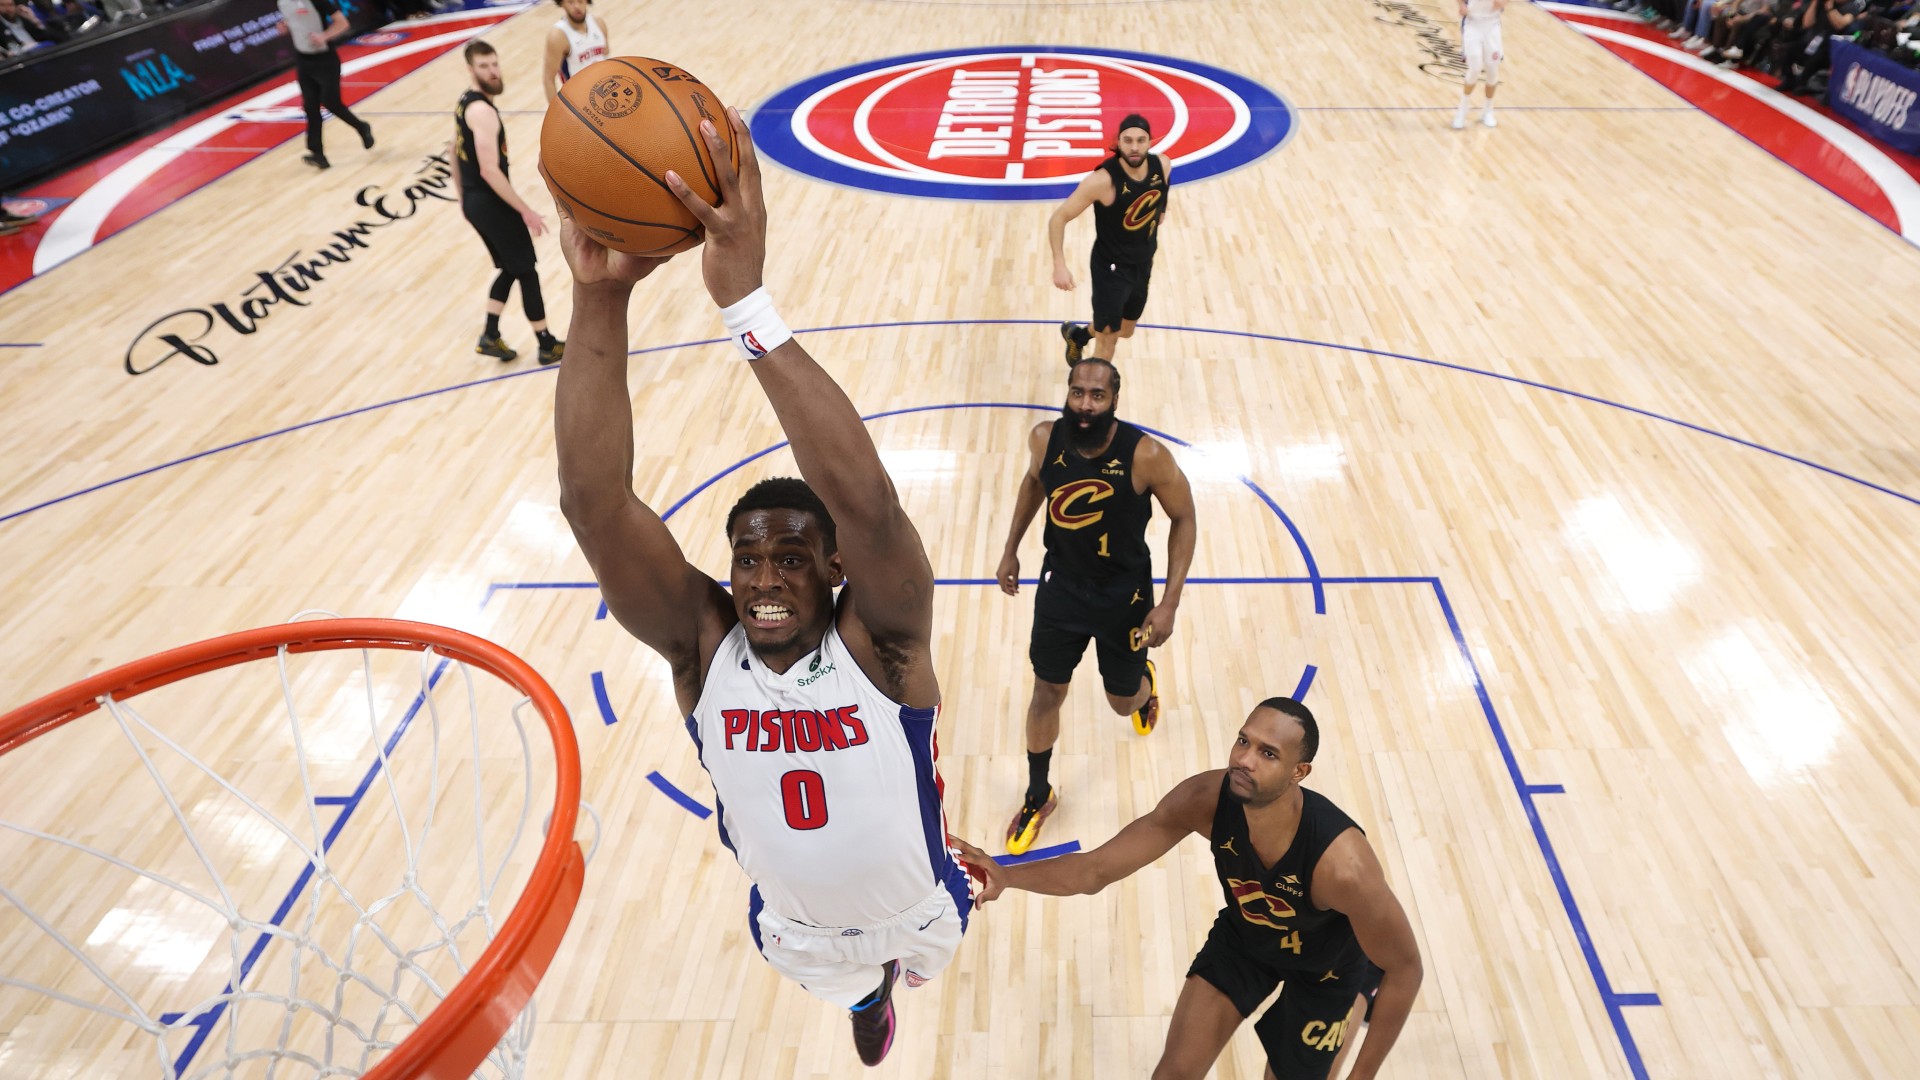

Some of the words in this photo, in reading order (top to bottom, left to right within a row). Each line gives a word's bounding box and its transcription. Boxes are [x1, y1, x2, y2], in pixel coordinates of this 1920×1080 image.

[927, 68, 1021, 160] DETROIT
[1021, 67, 1106, 160] PISTONS
[1848, 67, 1917, 131] PLAYOFFS
[123, 222, 372, 376] Platinum
[355, 141, 459, 220] Equit
[1101, 468, 1125, 477] CLIFFS
[1049, 478, 1115, 531] C
[1097, 532, 1111, 558] 1
[797, 661, 837, 688] StockX
[721, 703, 869, 754] PISTONS
[780, 769, 829, 831] 0
[1275, 882, 1304, 898] CLIFFS
[1280, 929, 1303, 955] 4
